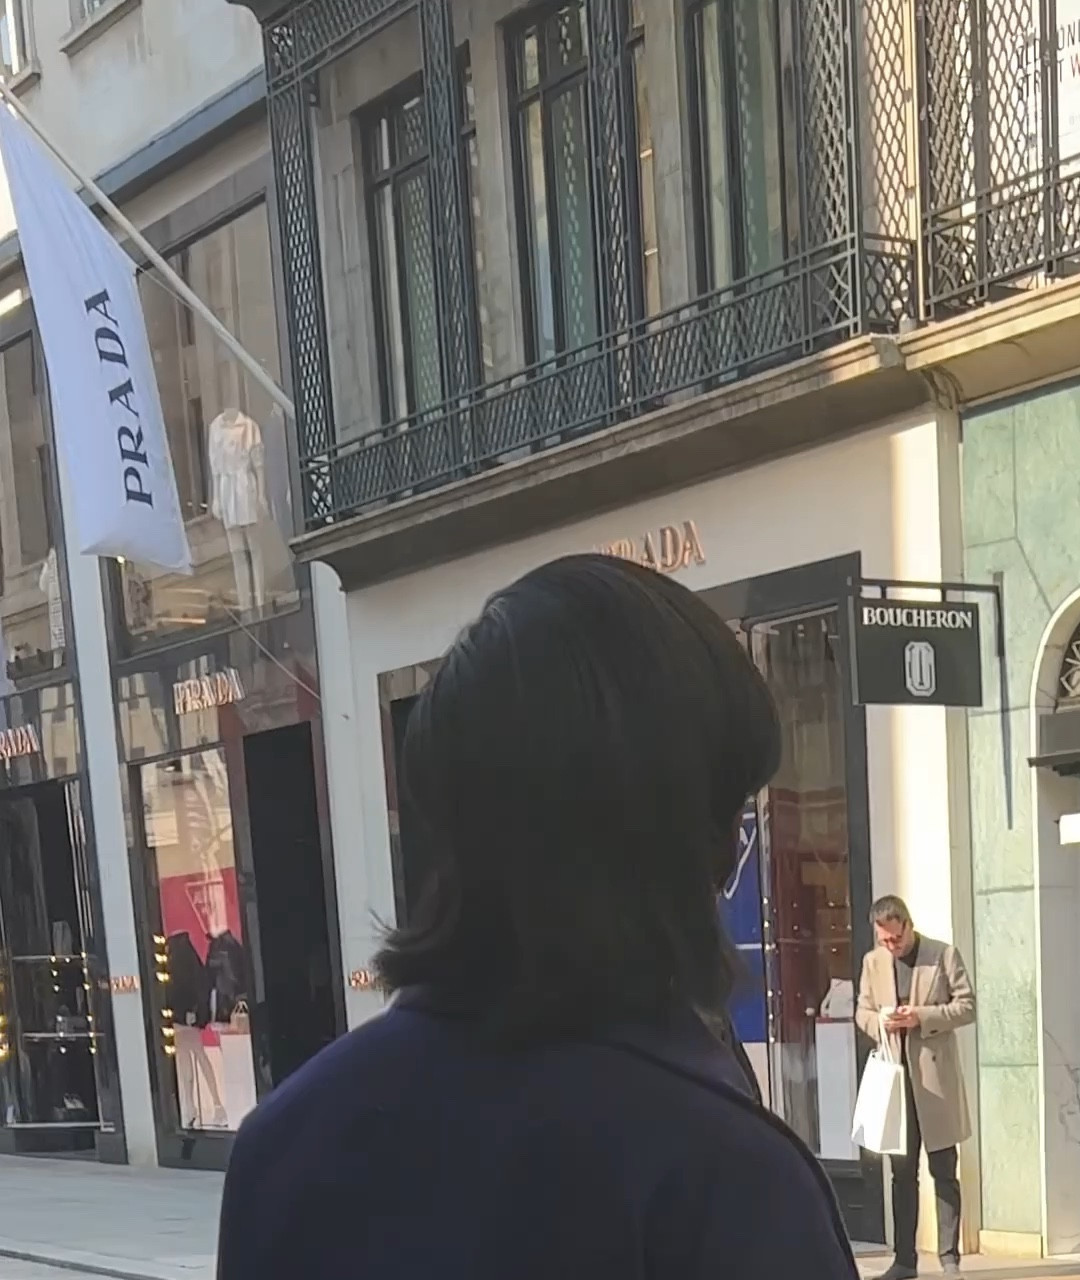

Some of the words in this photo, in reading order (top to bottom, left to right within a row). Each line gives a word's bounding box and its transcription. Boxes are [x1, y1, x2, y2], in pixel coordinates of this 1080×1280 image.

[84, 288, 154, 510] PRADA
[862, 606, 973, 629] BOUCHERON
[172, 667, 245, 716] PRADA
